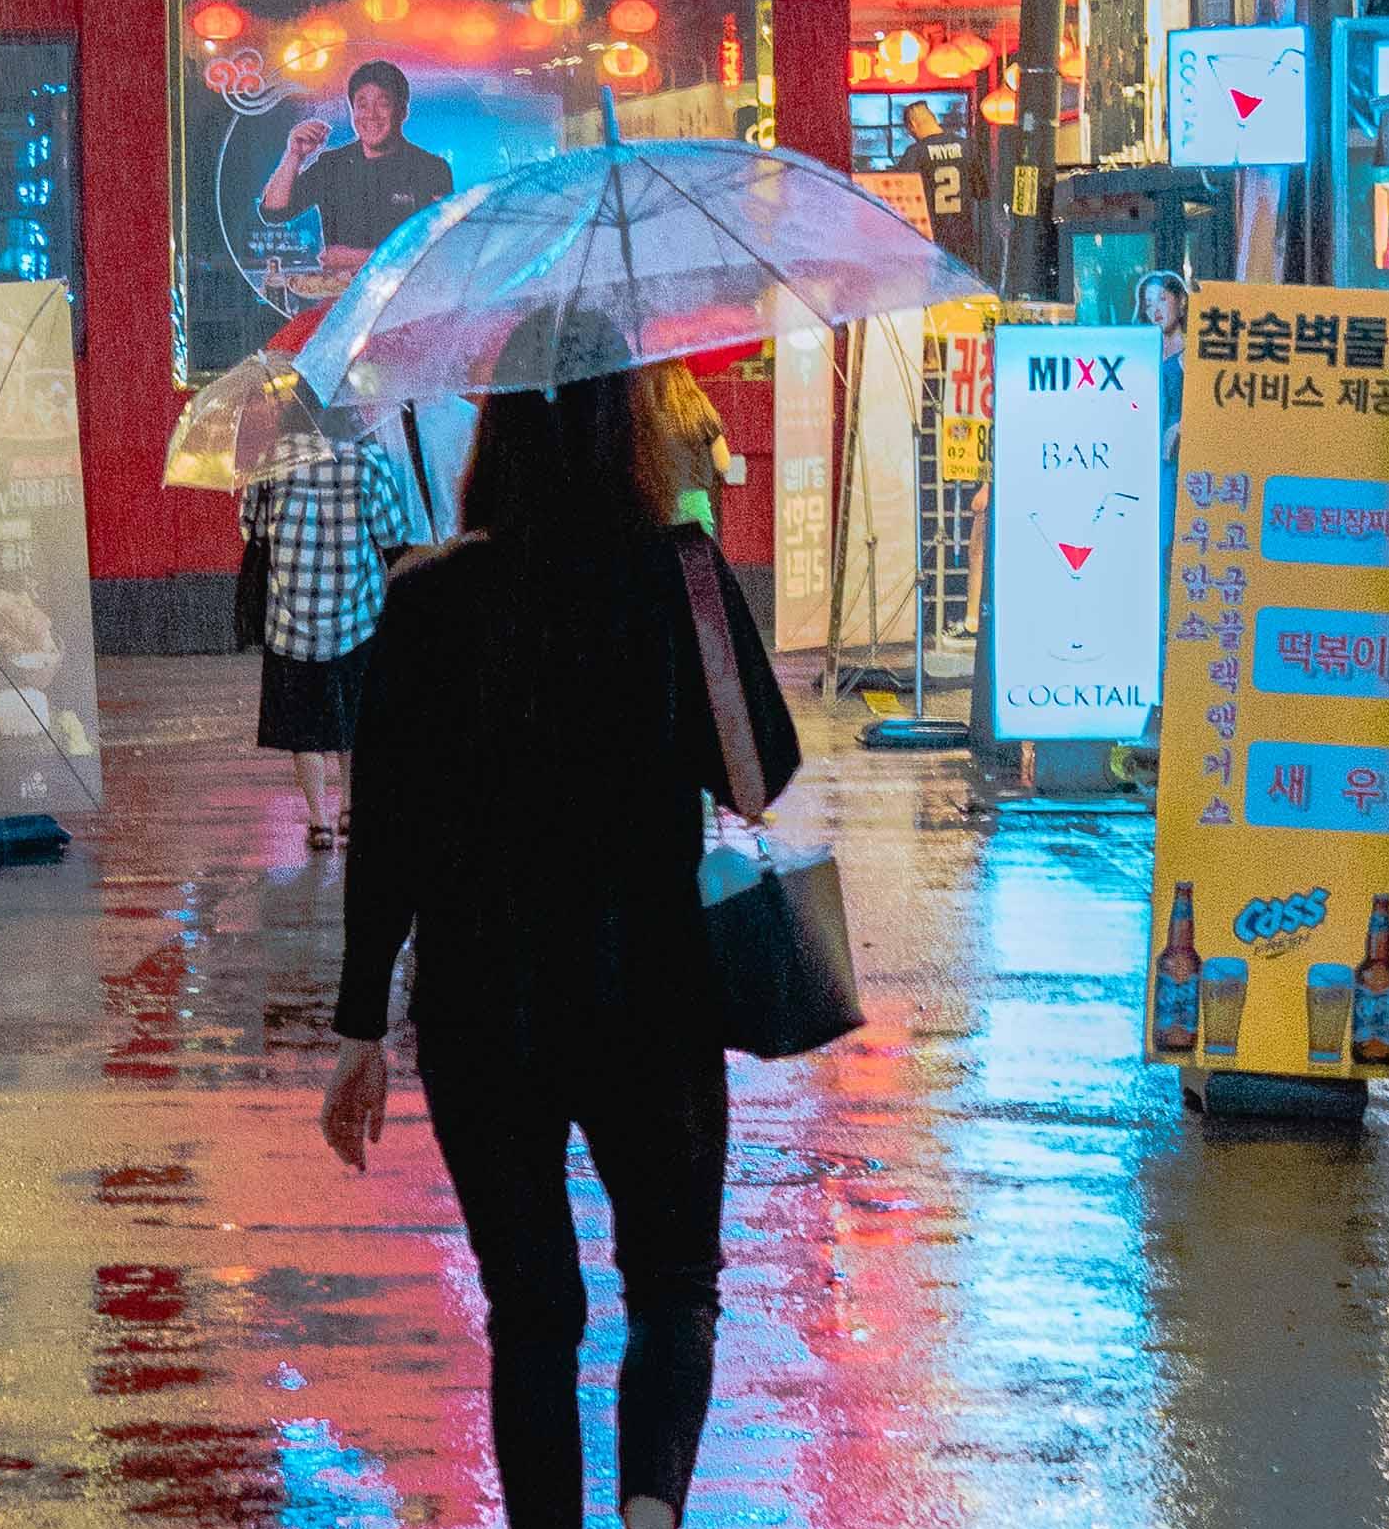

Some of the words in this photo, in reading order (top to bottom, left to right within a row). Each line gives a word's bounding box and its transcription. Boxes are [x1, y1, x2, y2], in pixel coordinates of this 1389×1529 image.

[934, 166, 961, 214] 2
[1028, 355, 1125, 392] MIXX
[1214, 370, 1324, 410] (서비스
[1042, 442, 1111, 470] BAR
[1277, 632, 1389, 677] 떡볶이
[1007, 684, 1147, 708] COCKTAIL
